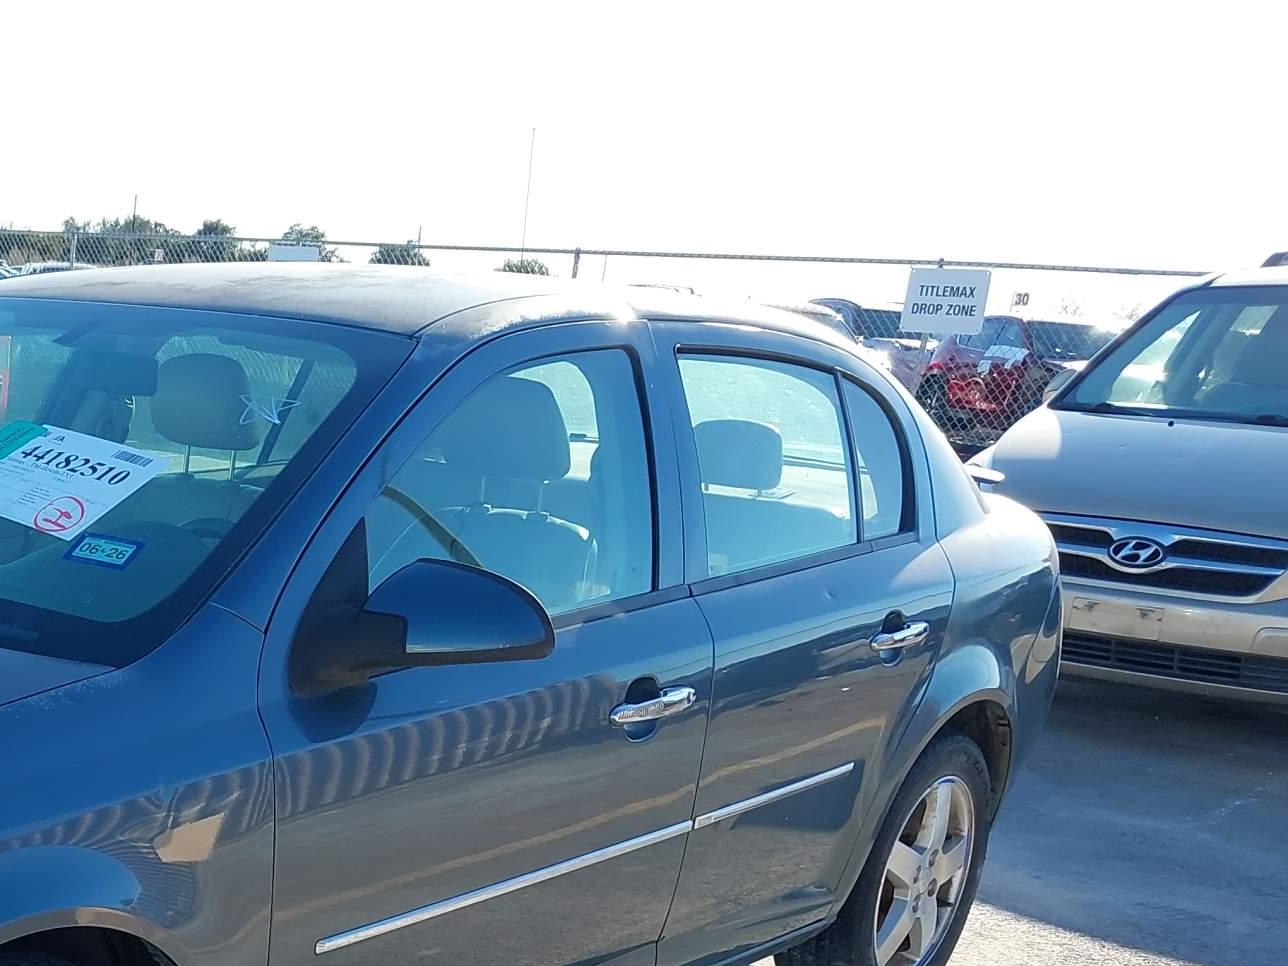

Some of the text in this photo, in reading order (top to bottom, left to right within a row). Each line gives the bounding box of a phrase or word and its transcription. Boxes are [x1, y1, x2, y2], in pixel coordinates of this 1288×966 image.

[919, 284, 977, 299] TITLEMAX
[1014, 292, 1030, 306] 30
[911, 302, 977, 317] DROP ZONE
[20, 445, 131, 486] 44182510
